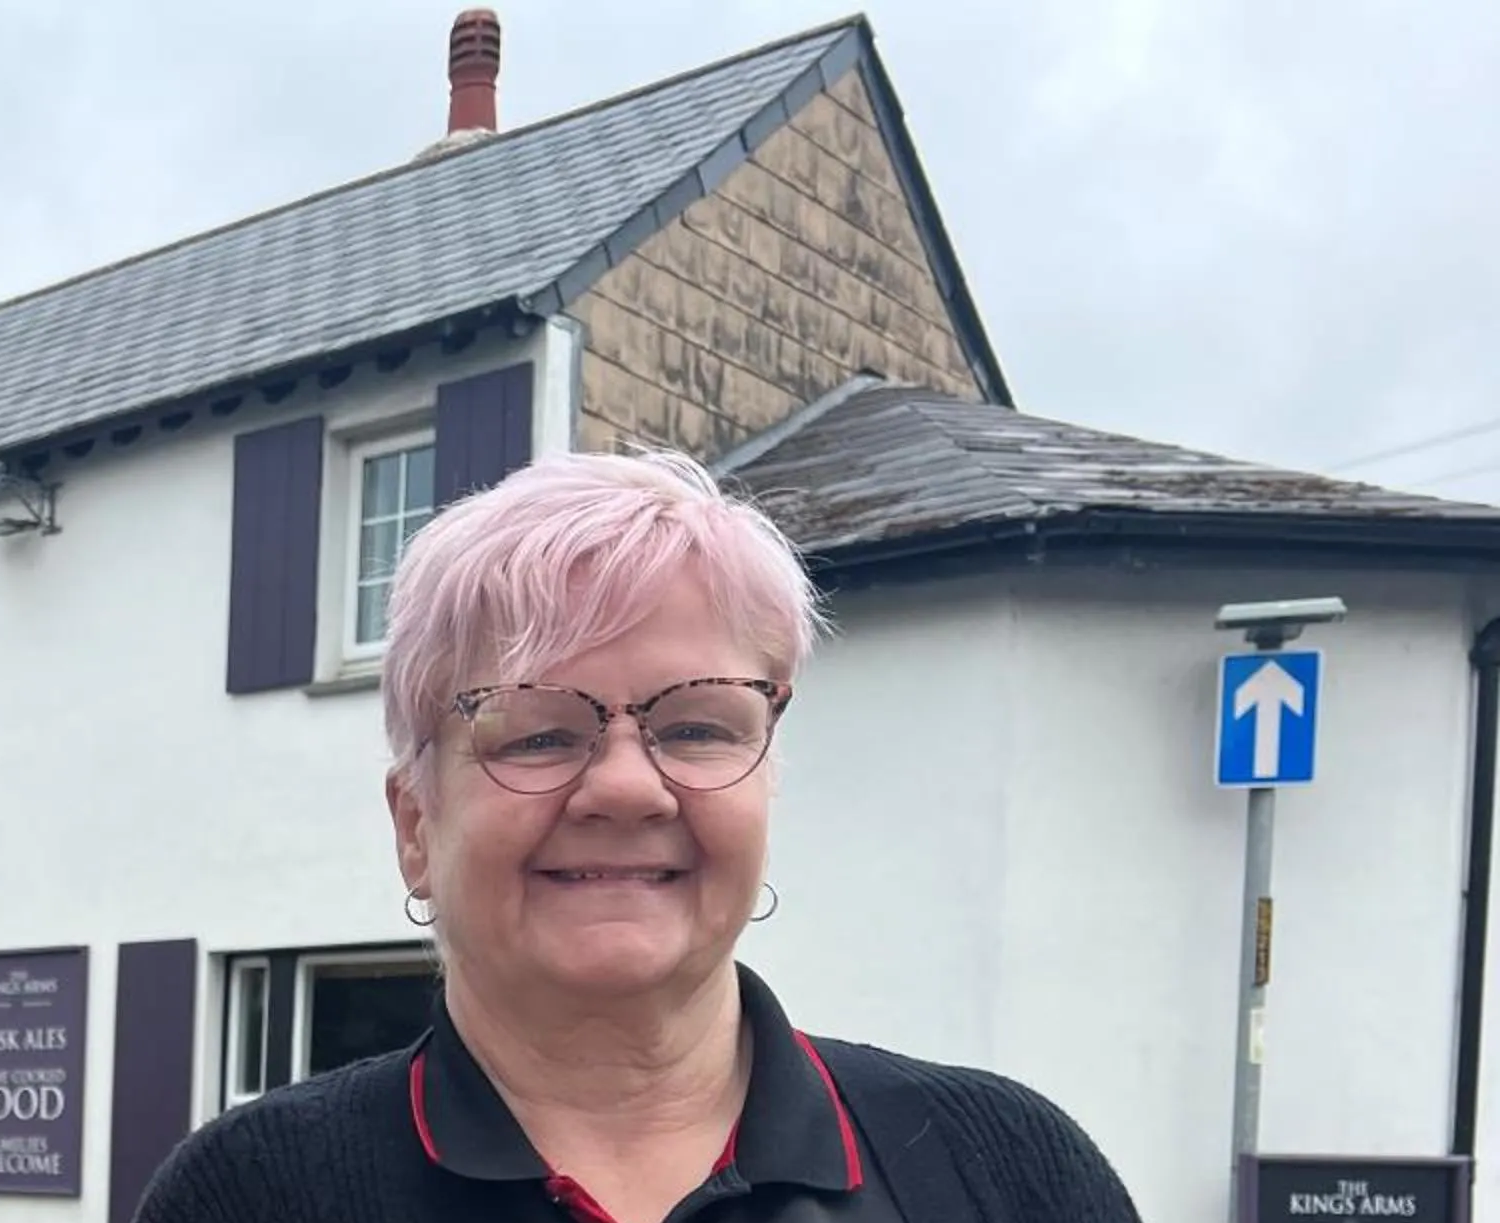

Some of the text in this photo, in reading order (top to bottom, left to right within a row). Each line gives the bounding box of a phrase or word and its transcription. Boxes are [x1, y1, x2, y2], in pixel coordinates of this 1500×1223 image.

[22, 1027, 67, 1050] ALES
[10, 1067, 67, 1084] COOKED
[1337, 1180, 1368, 1196] THE
[1290, 1194, 1416, 1216] KINGS ARMS
